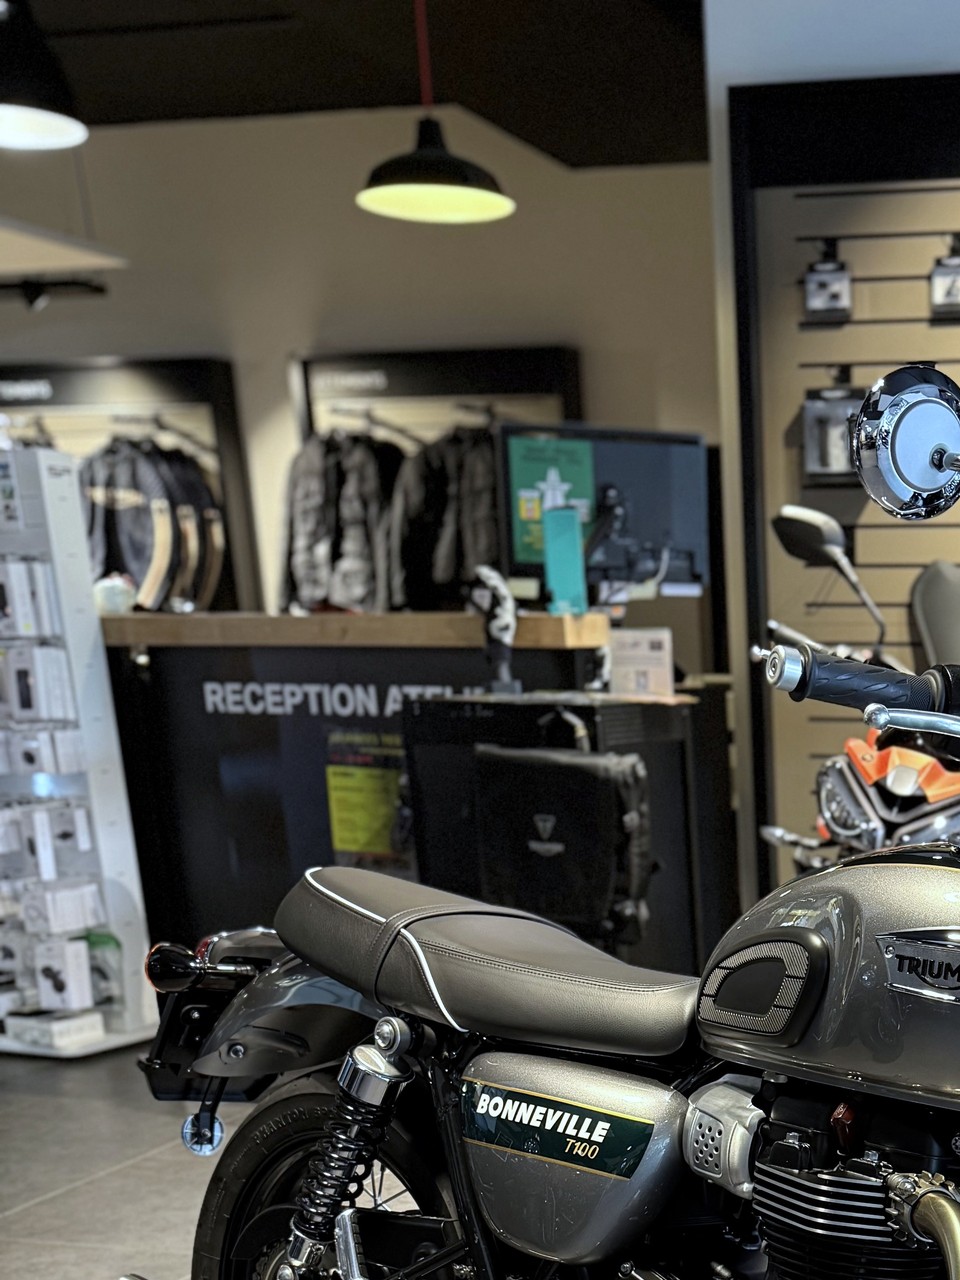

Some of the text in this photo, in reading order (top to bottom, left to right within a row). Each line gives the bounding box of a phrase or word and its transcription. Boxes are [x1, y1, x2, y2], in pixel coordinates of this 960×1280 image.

[203, 682, 379, 717] RECEPTION
[476, 1093, 612, 1144] BONNEVILLE
[565, 1138, 600, 1160] T100
